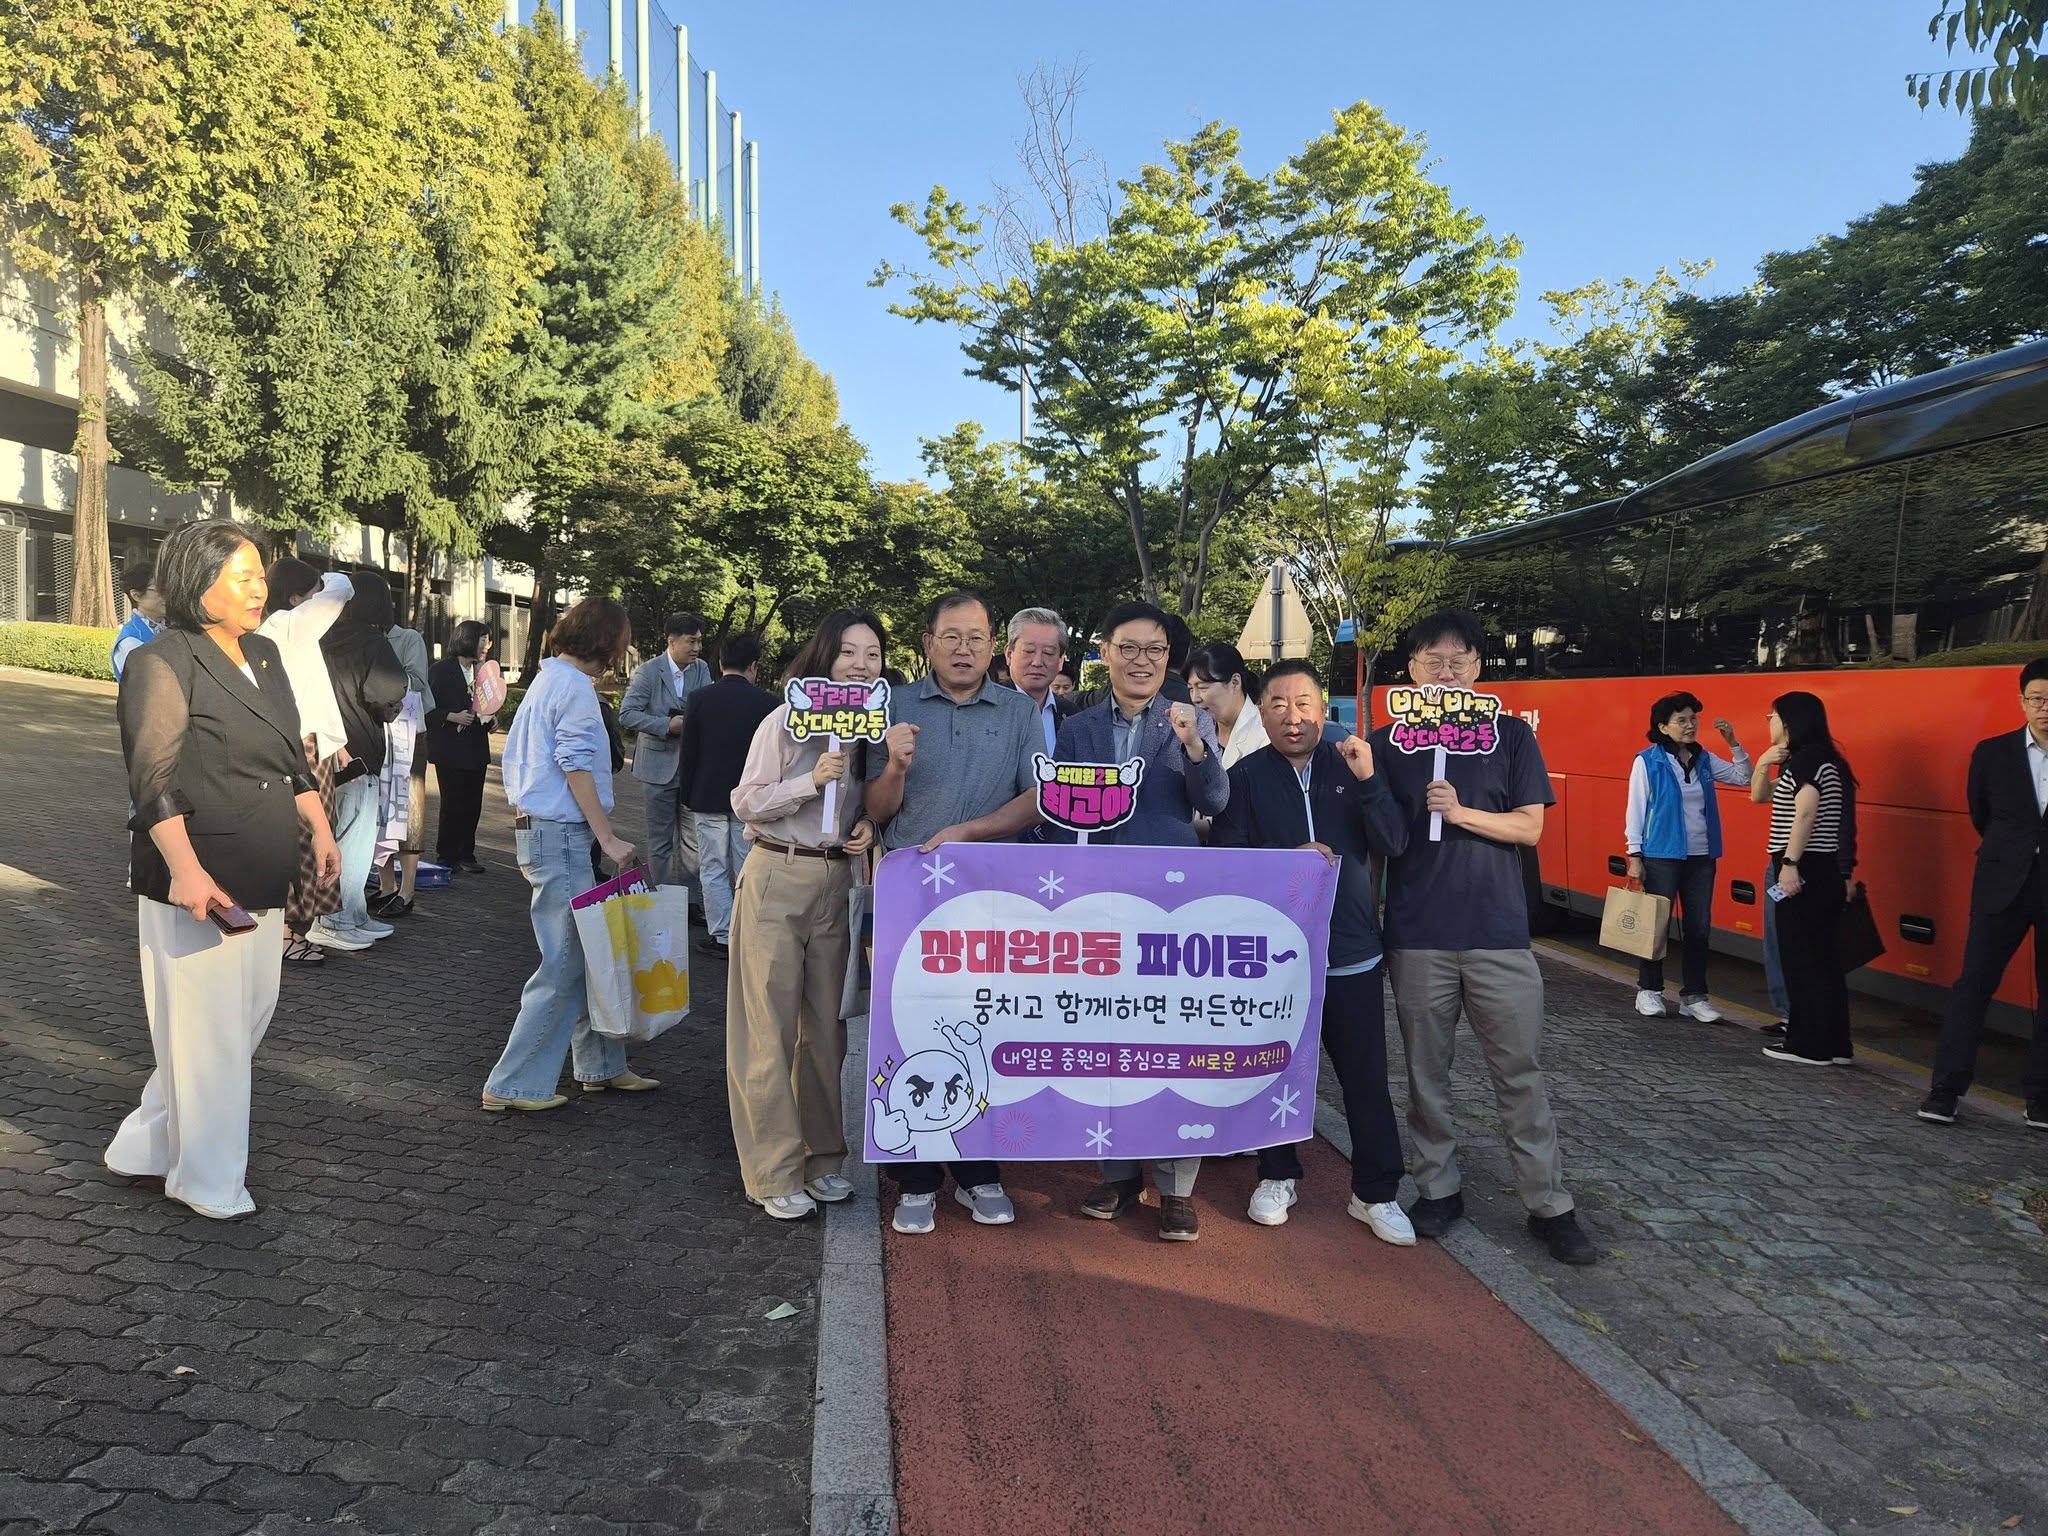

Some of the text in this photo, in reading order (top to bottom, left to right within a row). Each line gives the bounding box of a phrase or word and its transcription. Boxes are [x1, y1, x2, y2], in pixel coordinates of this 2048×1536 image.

[805, 683, 872, 710] 달려라
[1392, 691, 1497, 726] 반짝반짝
[788, 710, 885, 739] 상대원2동
[1394, 723, 1494, 750] 상대원2동
[1056, 767, 1118, 786] 상대원2동
[1042, 781, 1132, 824] 최고야
[1137, 933, 1298, 979] 파이팅~
[973, 988, 1293, 1027] 뭉치고 함께하면 뭐든한다!!
[1002, 1047, 1285, 1072] 내일은 중원의 중심으로 새로운 시작!!!
